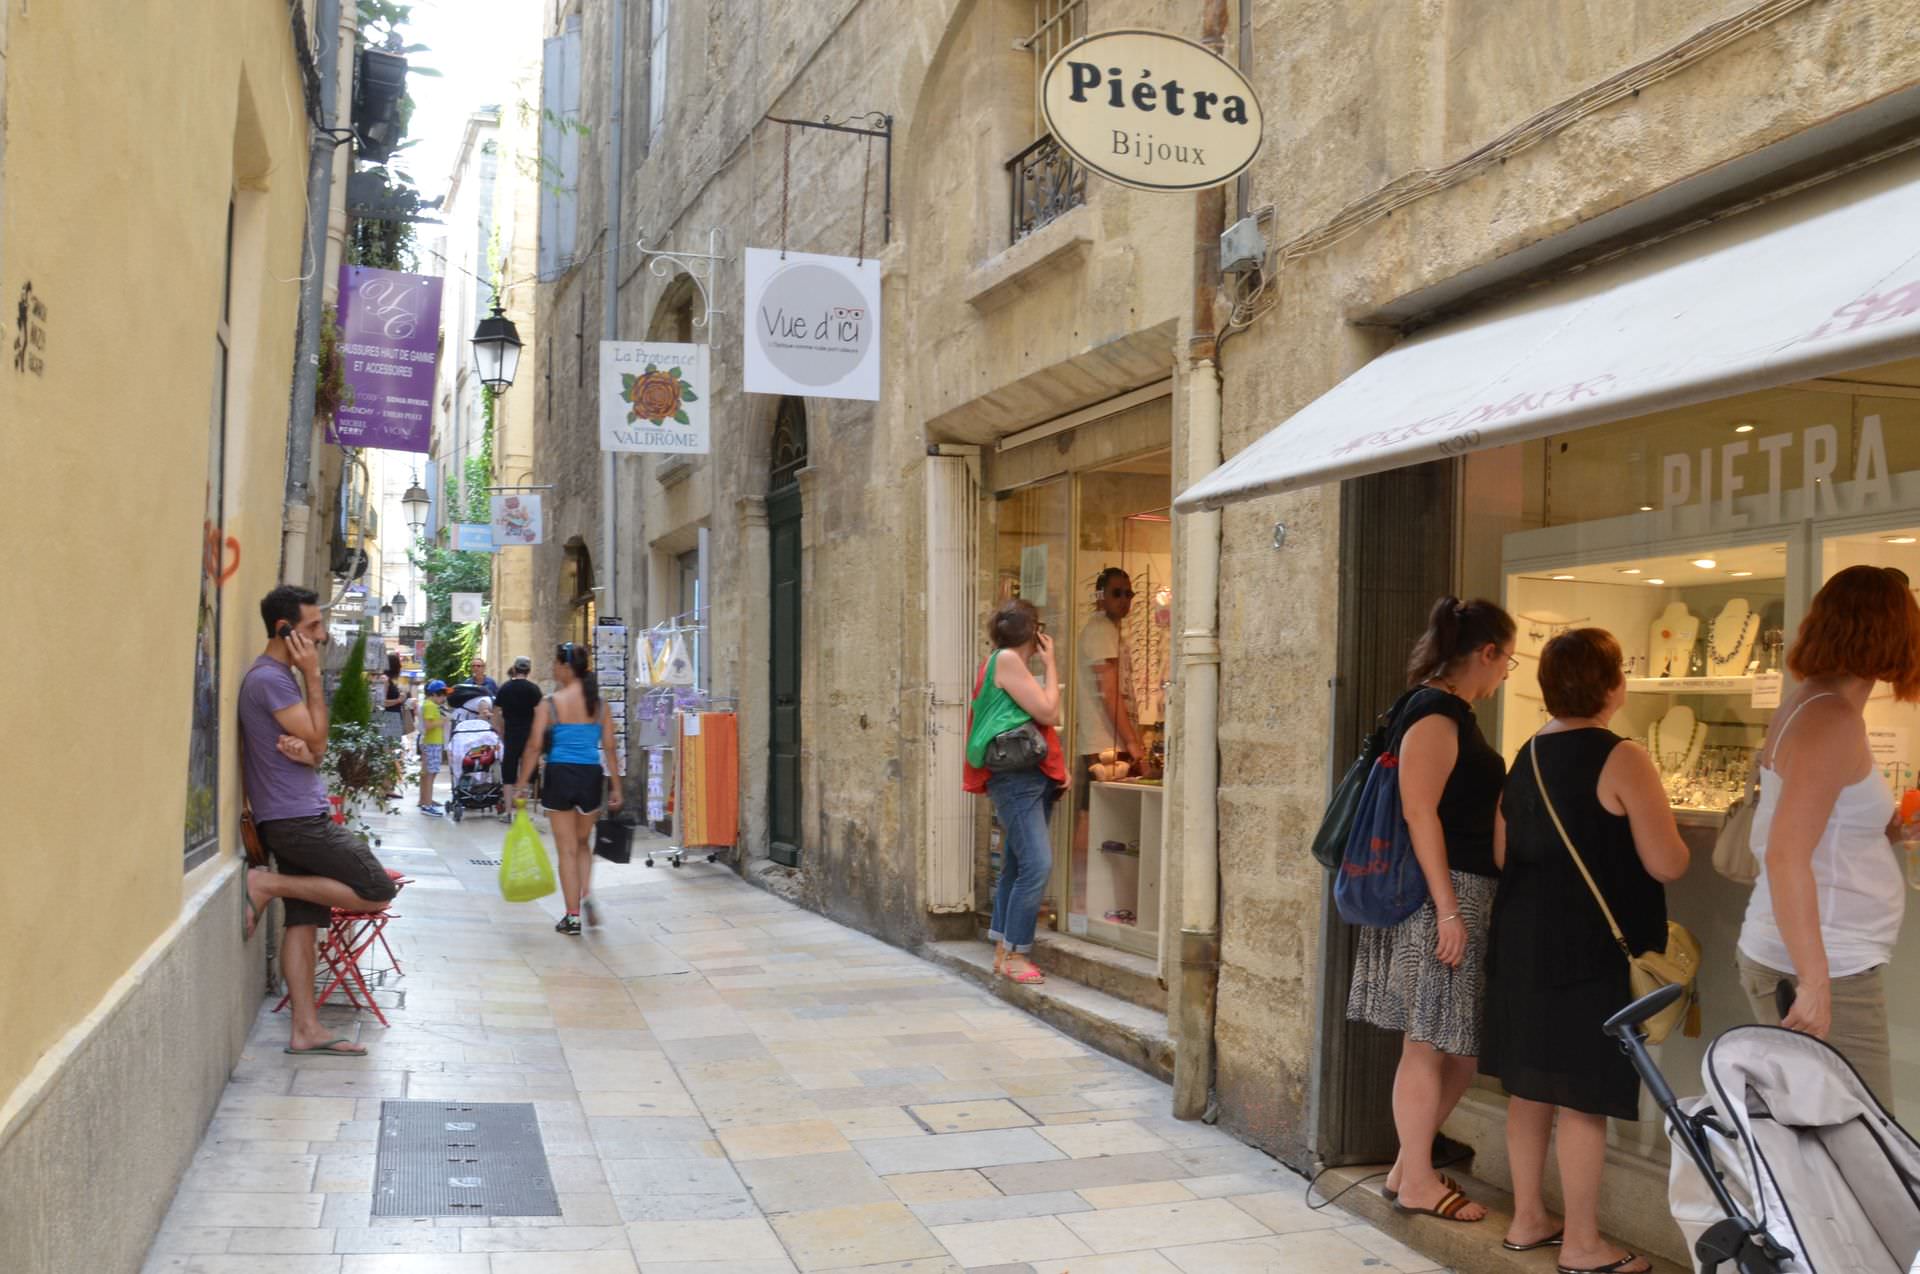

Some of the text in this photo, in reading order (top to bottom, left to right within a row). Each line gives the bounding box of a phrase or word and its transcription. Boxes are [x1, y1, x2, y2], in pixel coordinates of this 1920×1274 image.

[1067, 61, 1248, 125] Piétra
[1112, 129, 1207, 166] Bijoux
[762, 305, 808, 340] Vue
[381, 347, 399, 360] HAUT
[399, 349, 410, 362] DE
[410, 350, 436, 364] GAMME
[614, 347, 632, 362] La
[353, 360, 414, 378] ET ACCESSOIRES
[613, 429, 699, 447] VALDRÔME
[1661, 414, 1892, 537] PIETRA
